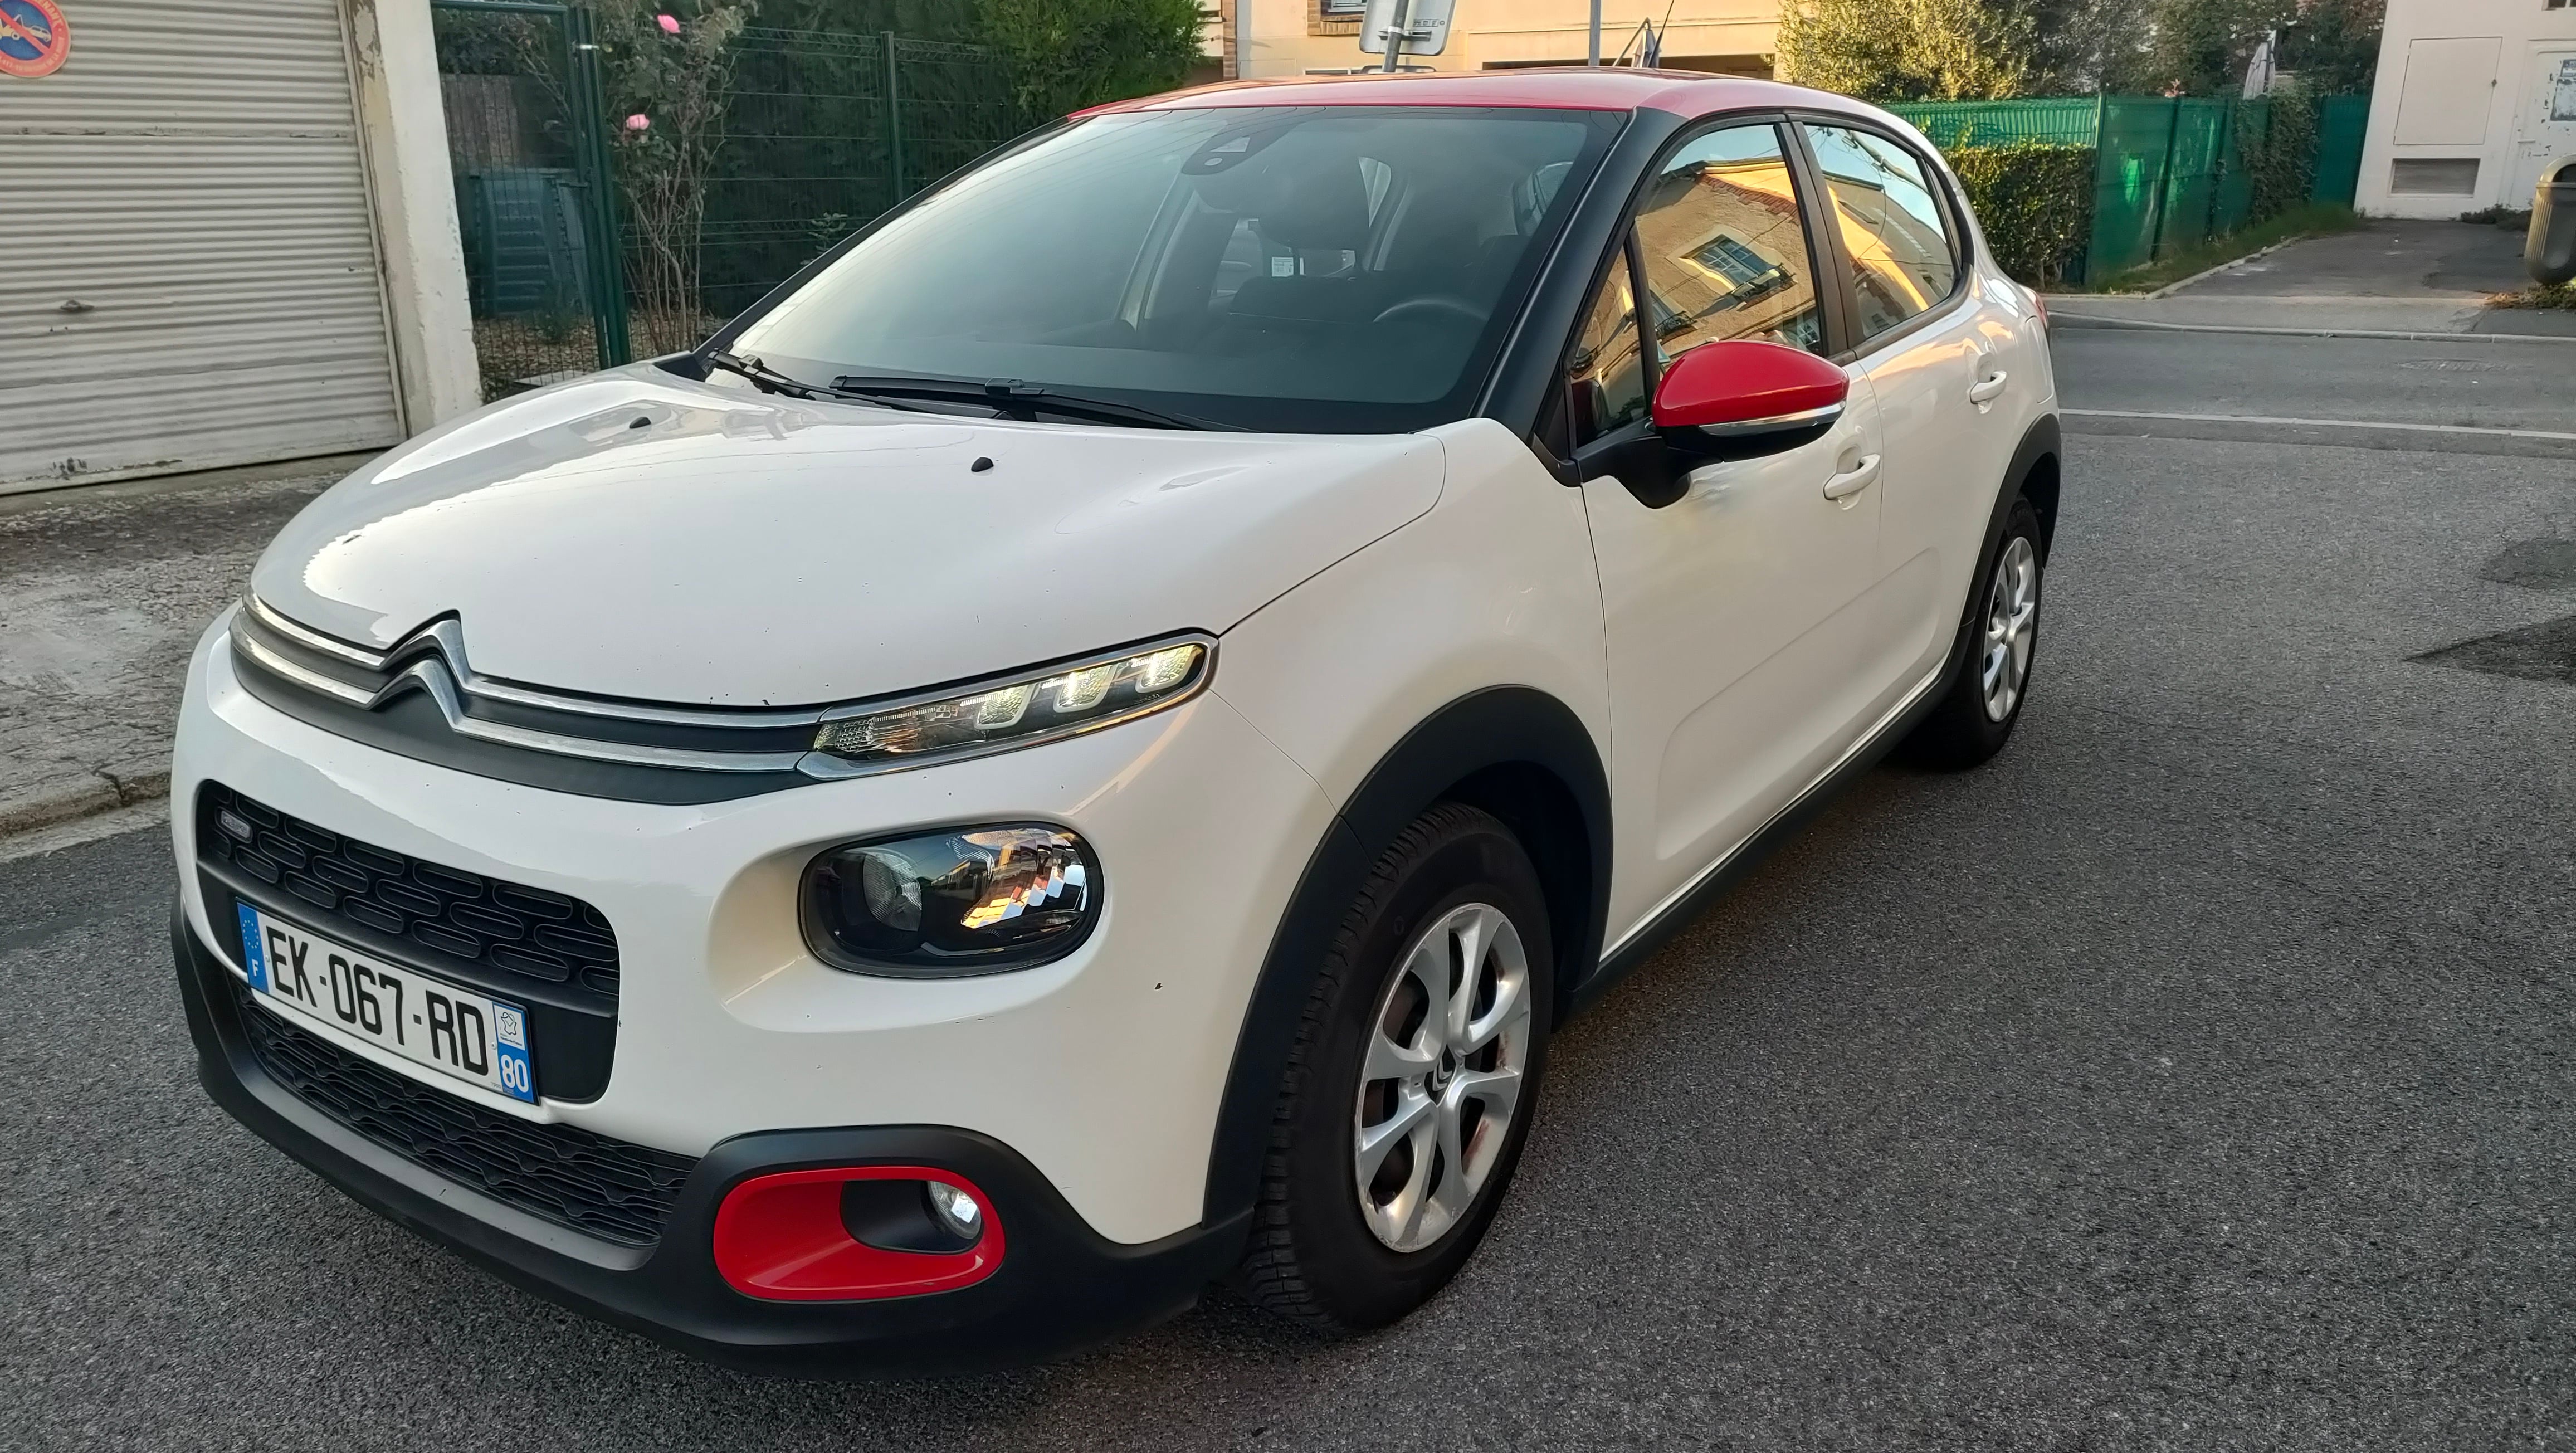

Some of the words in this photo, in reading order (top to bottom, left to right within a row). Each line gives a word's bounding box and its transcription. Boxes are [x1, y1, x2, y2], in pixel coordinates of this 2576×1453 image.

[252, 959, 258, 977] F
[266, 925, 489, 1076] EK-067-RD
[500, 1054, 529, 1093] 80
